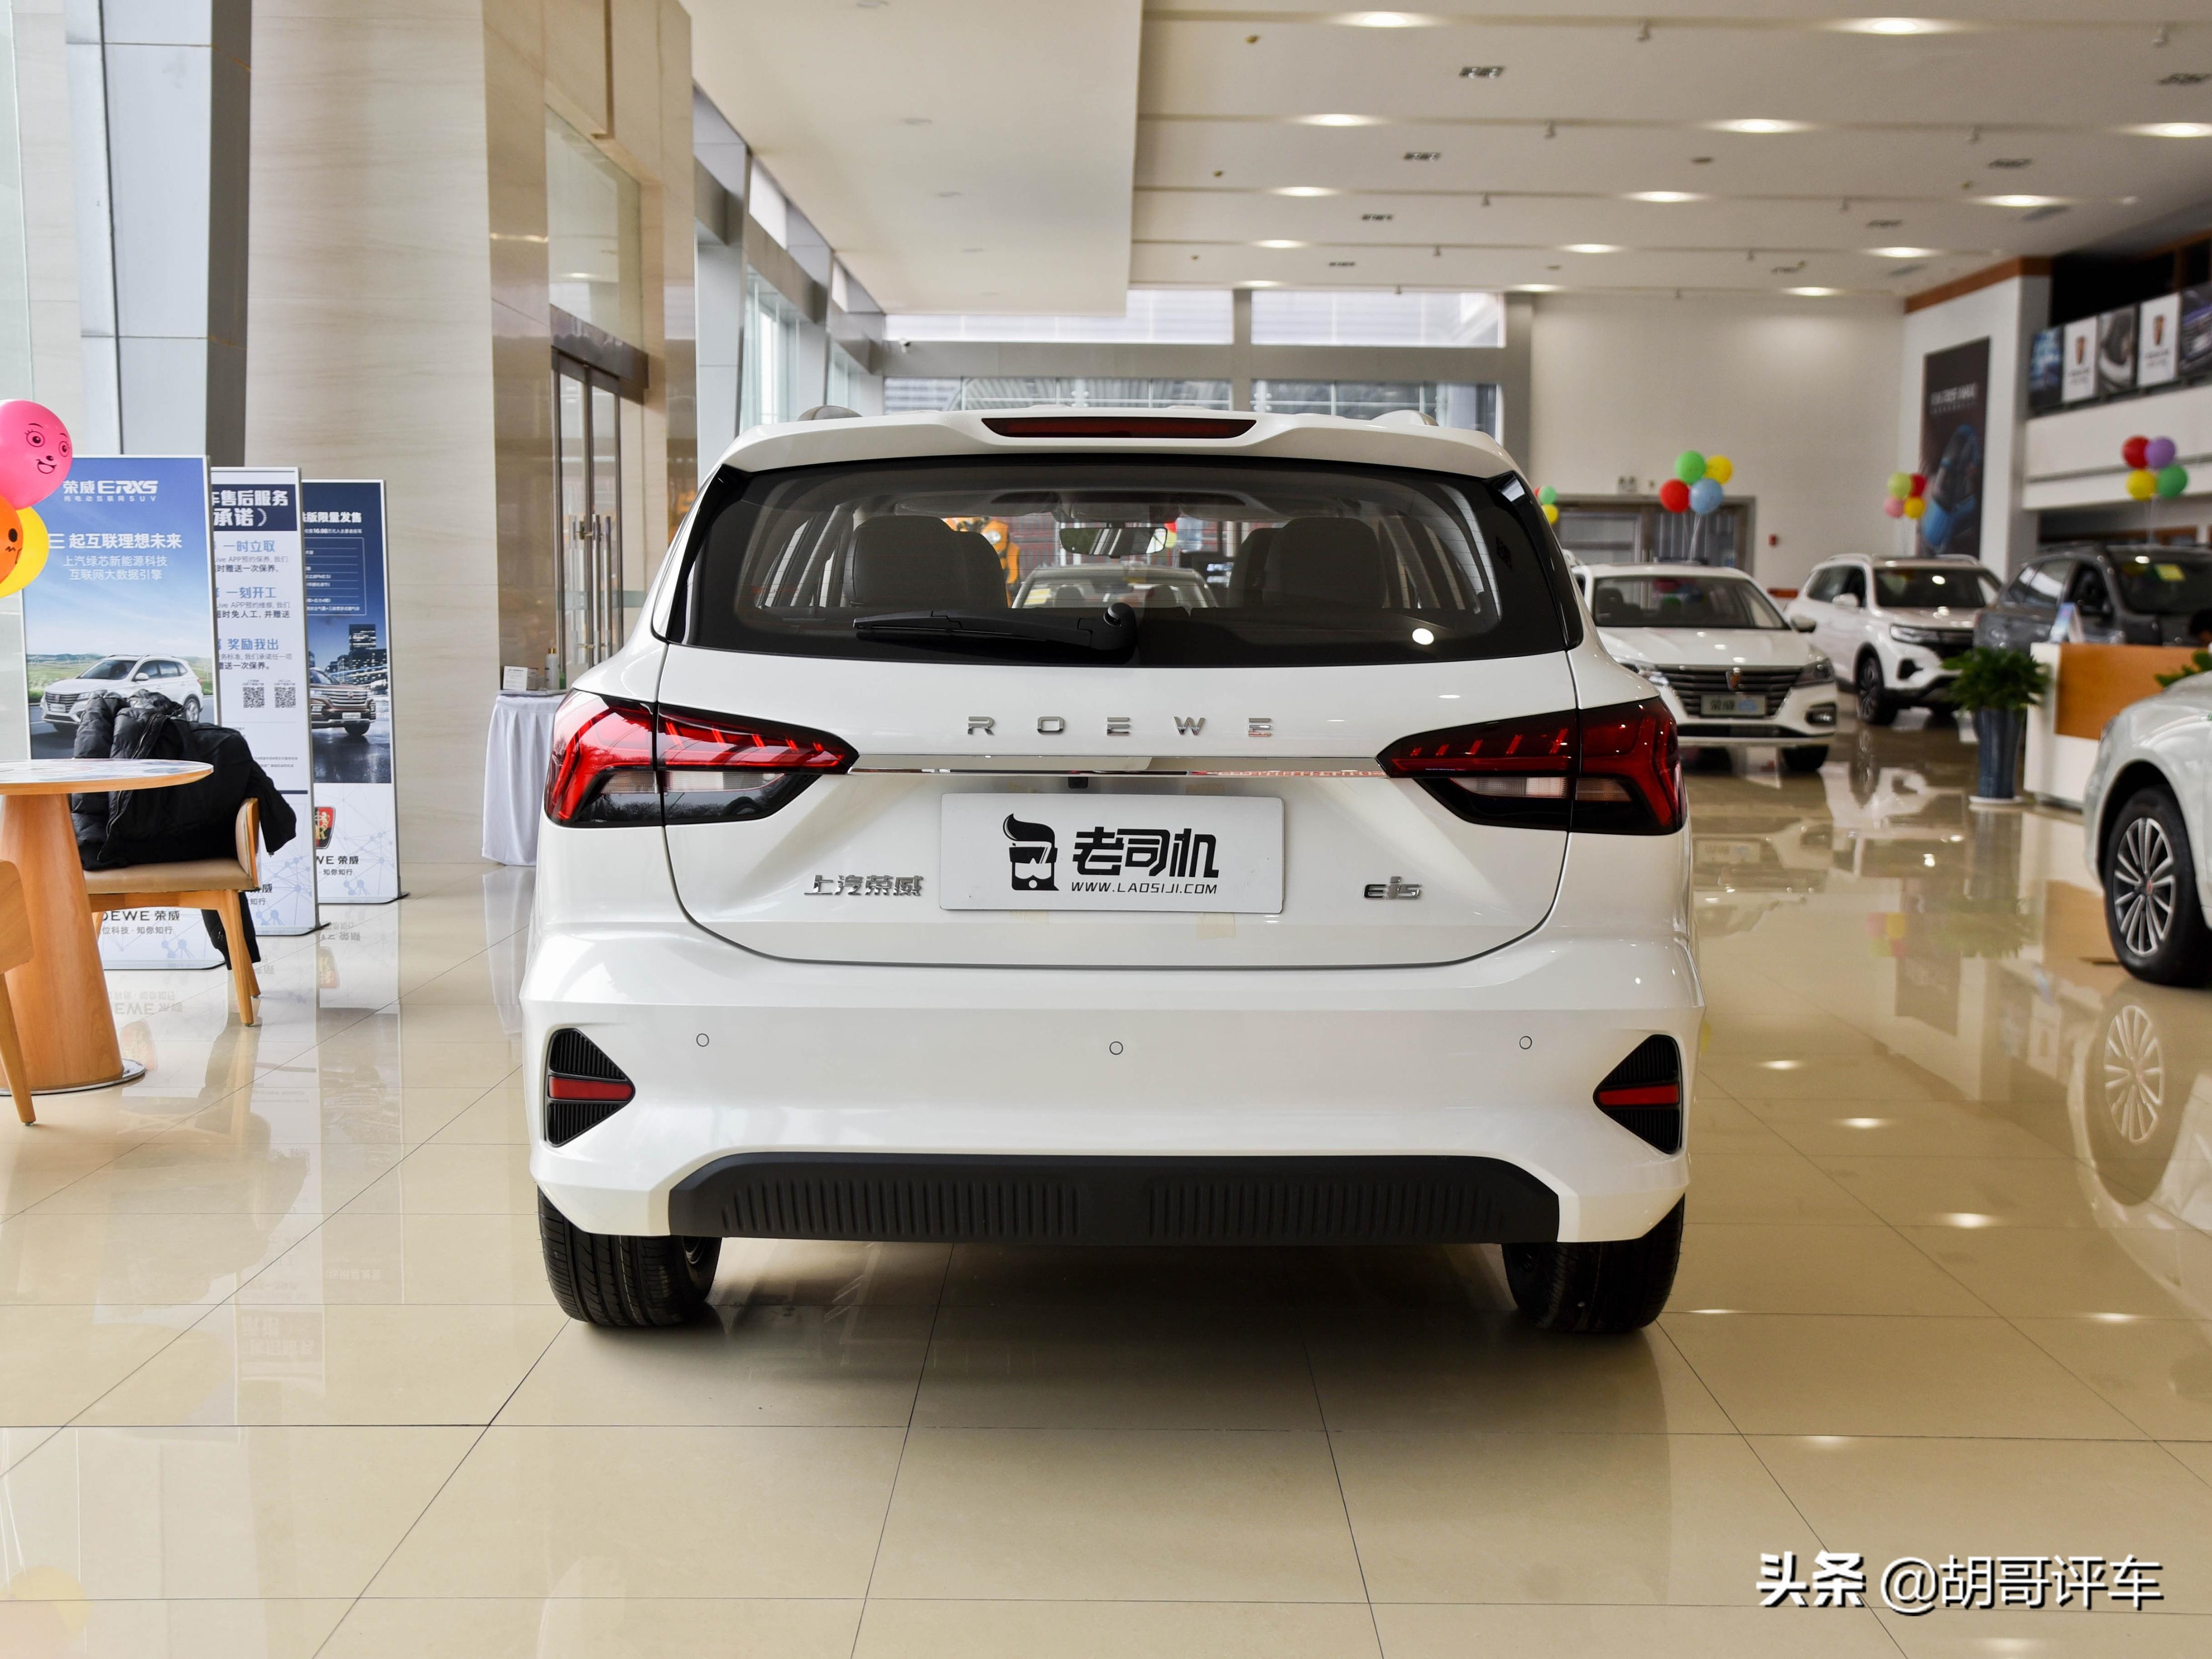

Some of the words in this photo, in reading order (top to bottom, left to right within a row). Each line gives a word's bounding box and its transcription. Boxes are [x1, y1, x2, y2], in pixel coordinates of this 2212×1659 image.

[63, 481, 96, 494] 荣威
[223, 540, 275, 552] 一时立取
[68, 569, 163, 580] 互联网大数据引擎
[226, 586, 276, 599] 一刻开工
[227, 638, 279, 651] 奖励我出
[967, 716, 1274, 738] ROEWE
[1072, 826, 1220, 879] 老司机
[338, 856, 359, 865] 荣威
[803, 874, 925, 897] 上汽荣威
[1071, 881, 1218, 895] WWW.LAOSIJI.COM
[154, 910, 180, 921] 荣威
